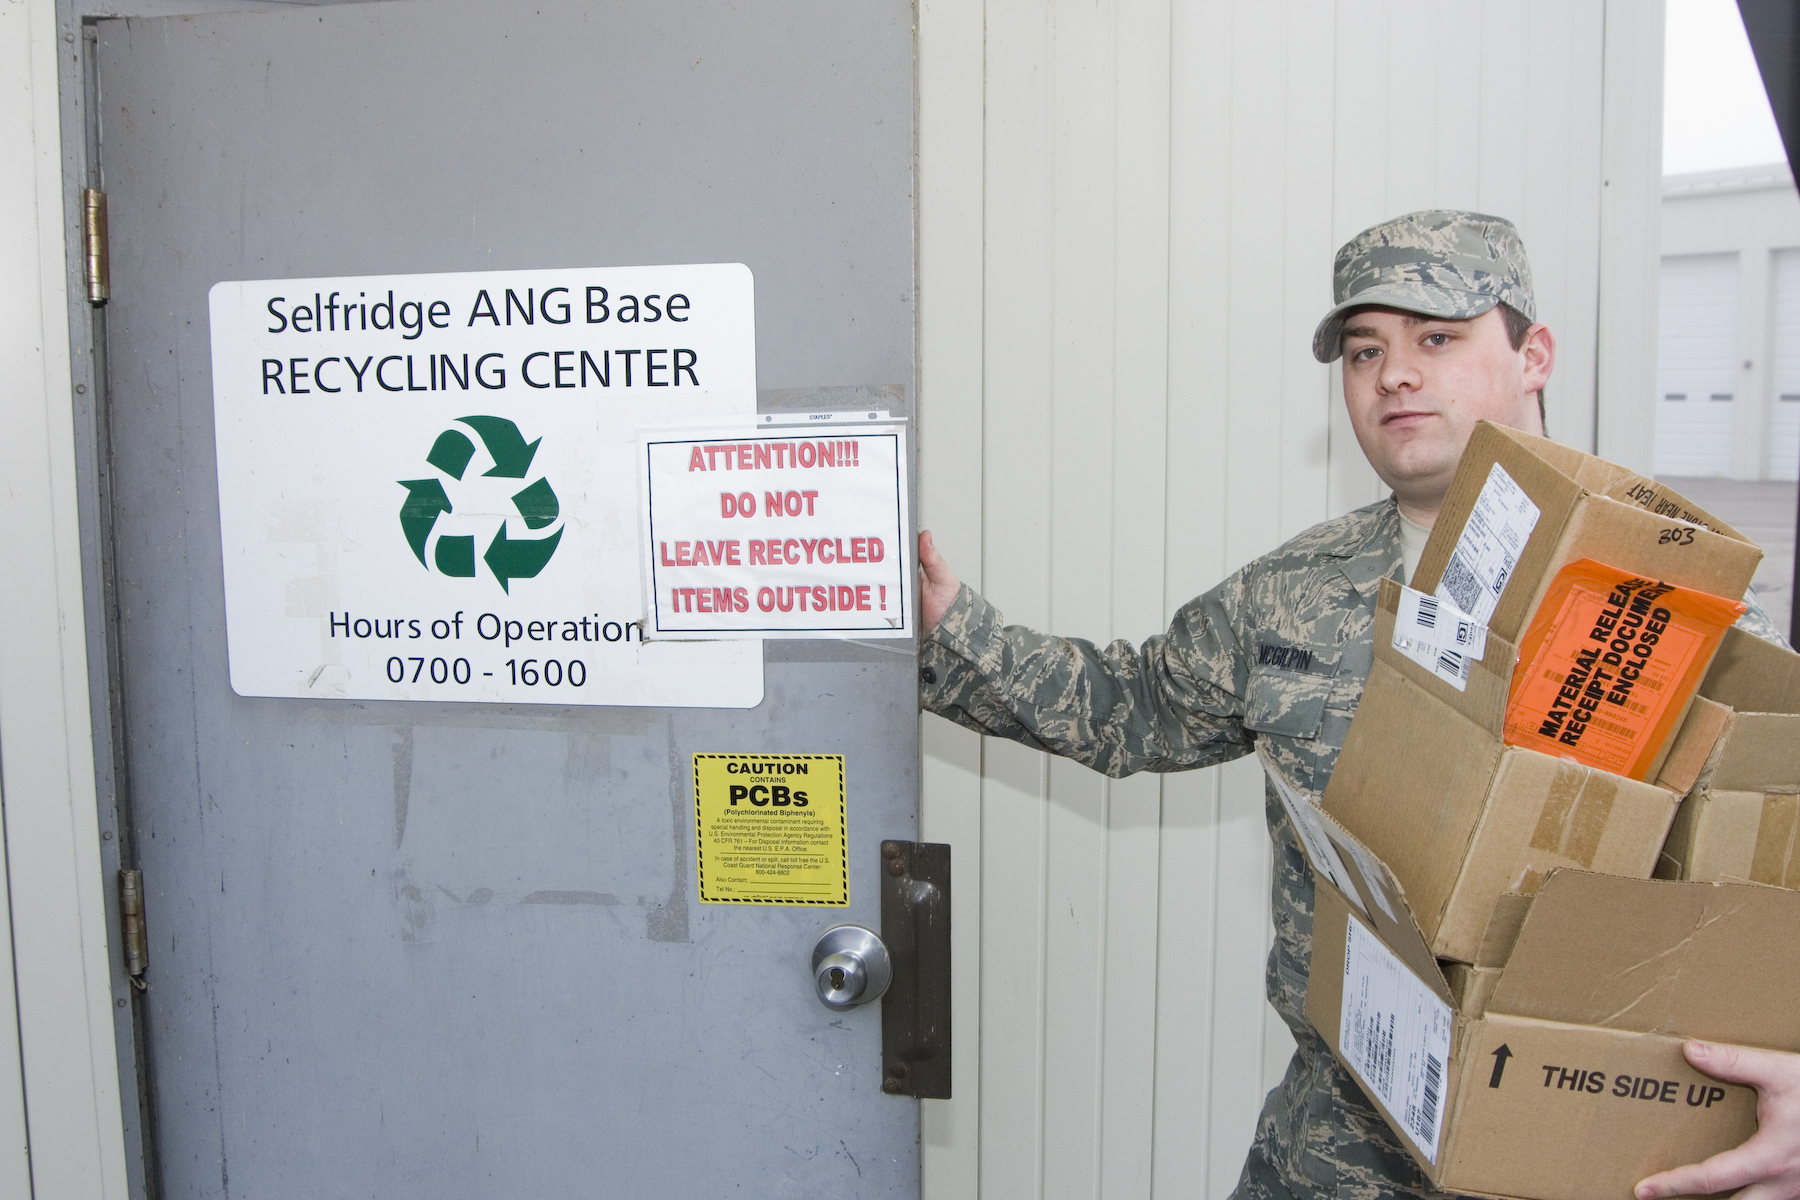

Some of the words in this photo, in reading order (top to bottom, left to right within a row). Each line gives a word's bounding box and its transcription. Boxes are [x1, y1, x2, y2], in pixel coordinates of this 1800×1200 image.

[267, 292, 451, 339] Selfridge
[467, 288, 572, 327] ANG
[586, 286, 691, 323] Base
[262, 353, 504, 395] RECYCLING
[521, 348, 700, 389] CENTER
[689, 441, 858, 471] ATTENTION!!!
[720, 493, 756, 518] DO
[765, 491, 818, 517] NOT
[1659, 528, 1696, 545] 303
[661, 540, 741, 566] LEAVE
[750, 538, 884, 565] RECYCLED
[673, 588, 749, 613] ITEMS
[758, 586, 871, 612] OUTSIDE
[880, 586, 886, 610] !
[330, 611, 421, 639] Hours
[431, 611, 463, 640] of
[477, 612, 644, 647] Operation
[387, 657, 471, 684] 0700
[506, 659, 586, 686] 1600
[1559, 667, 1613, 746] RECEIPT
[1602, 581, 1676, 667] DOCUMENT
[1606, 608, 1671, 706] ENCLOSED
[1538, 648, 1602, 738] MATERIAL
[727, 763, 808, 774] CAUTION
[730, 785, 808, 807] PCBs
[1542, 1065, 1606, 1094] THIS
[1612, 1075, 1680, 1103] SIDE
[1686, 1084, 1725, 1108] UP
